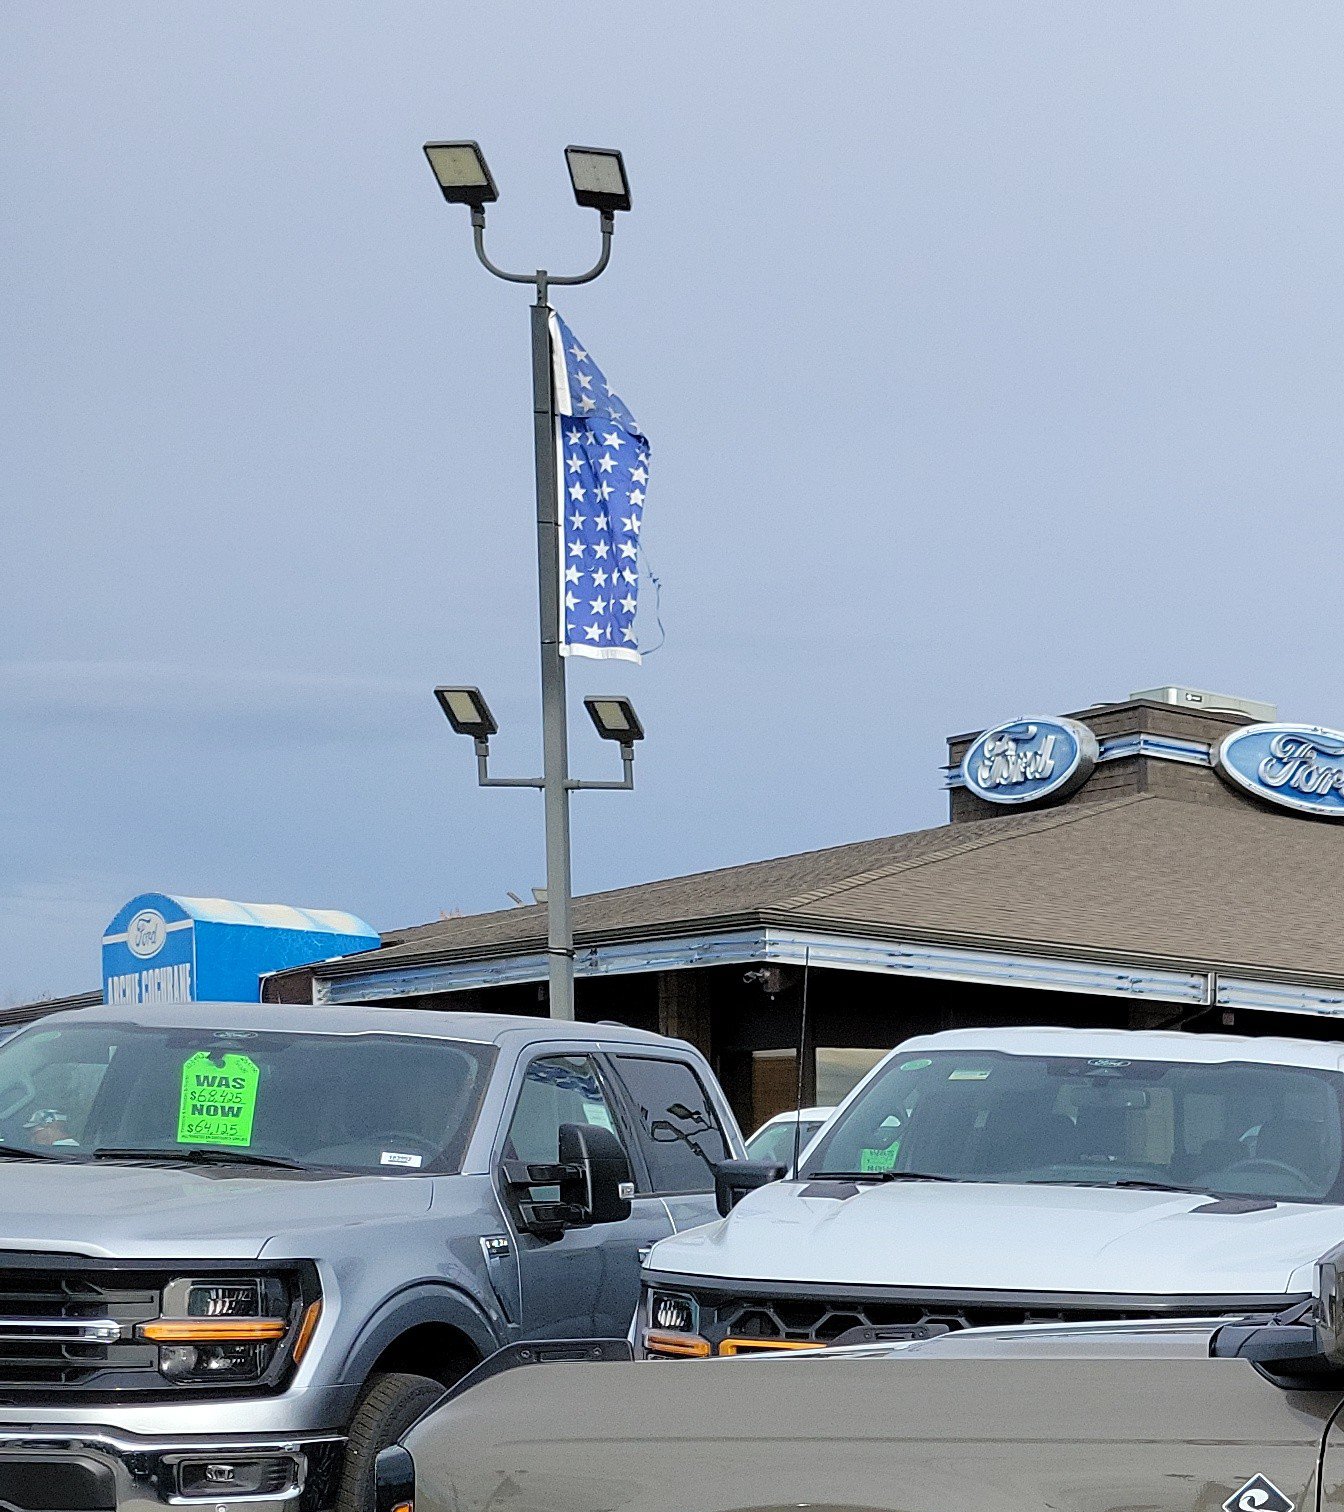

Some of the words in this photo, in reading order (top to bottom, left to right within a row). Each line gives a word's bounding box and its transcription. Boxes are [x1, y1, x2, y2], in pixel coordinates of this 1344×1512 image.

[978, 725, 1055, 786] Ford
[195, 1074, 246, 1090] WAS
[191, 1103, 243, 1118] NOW
